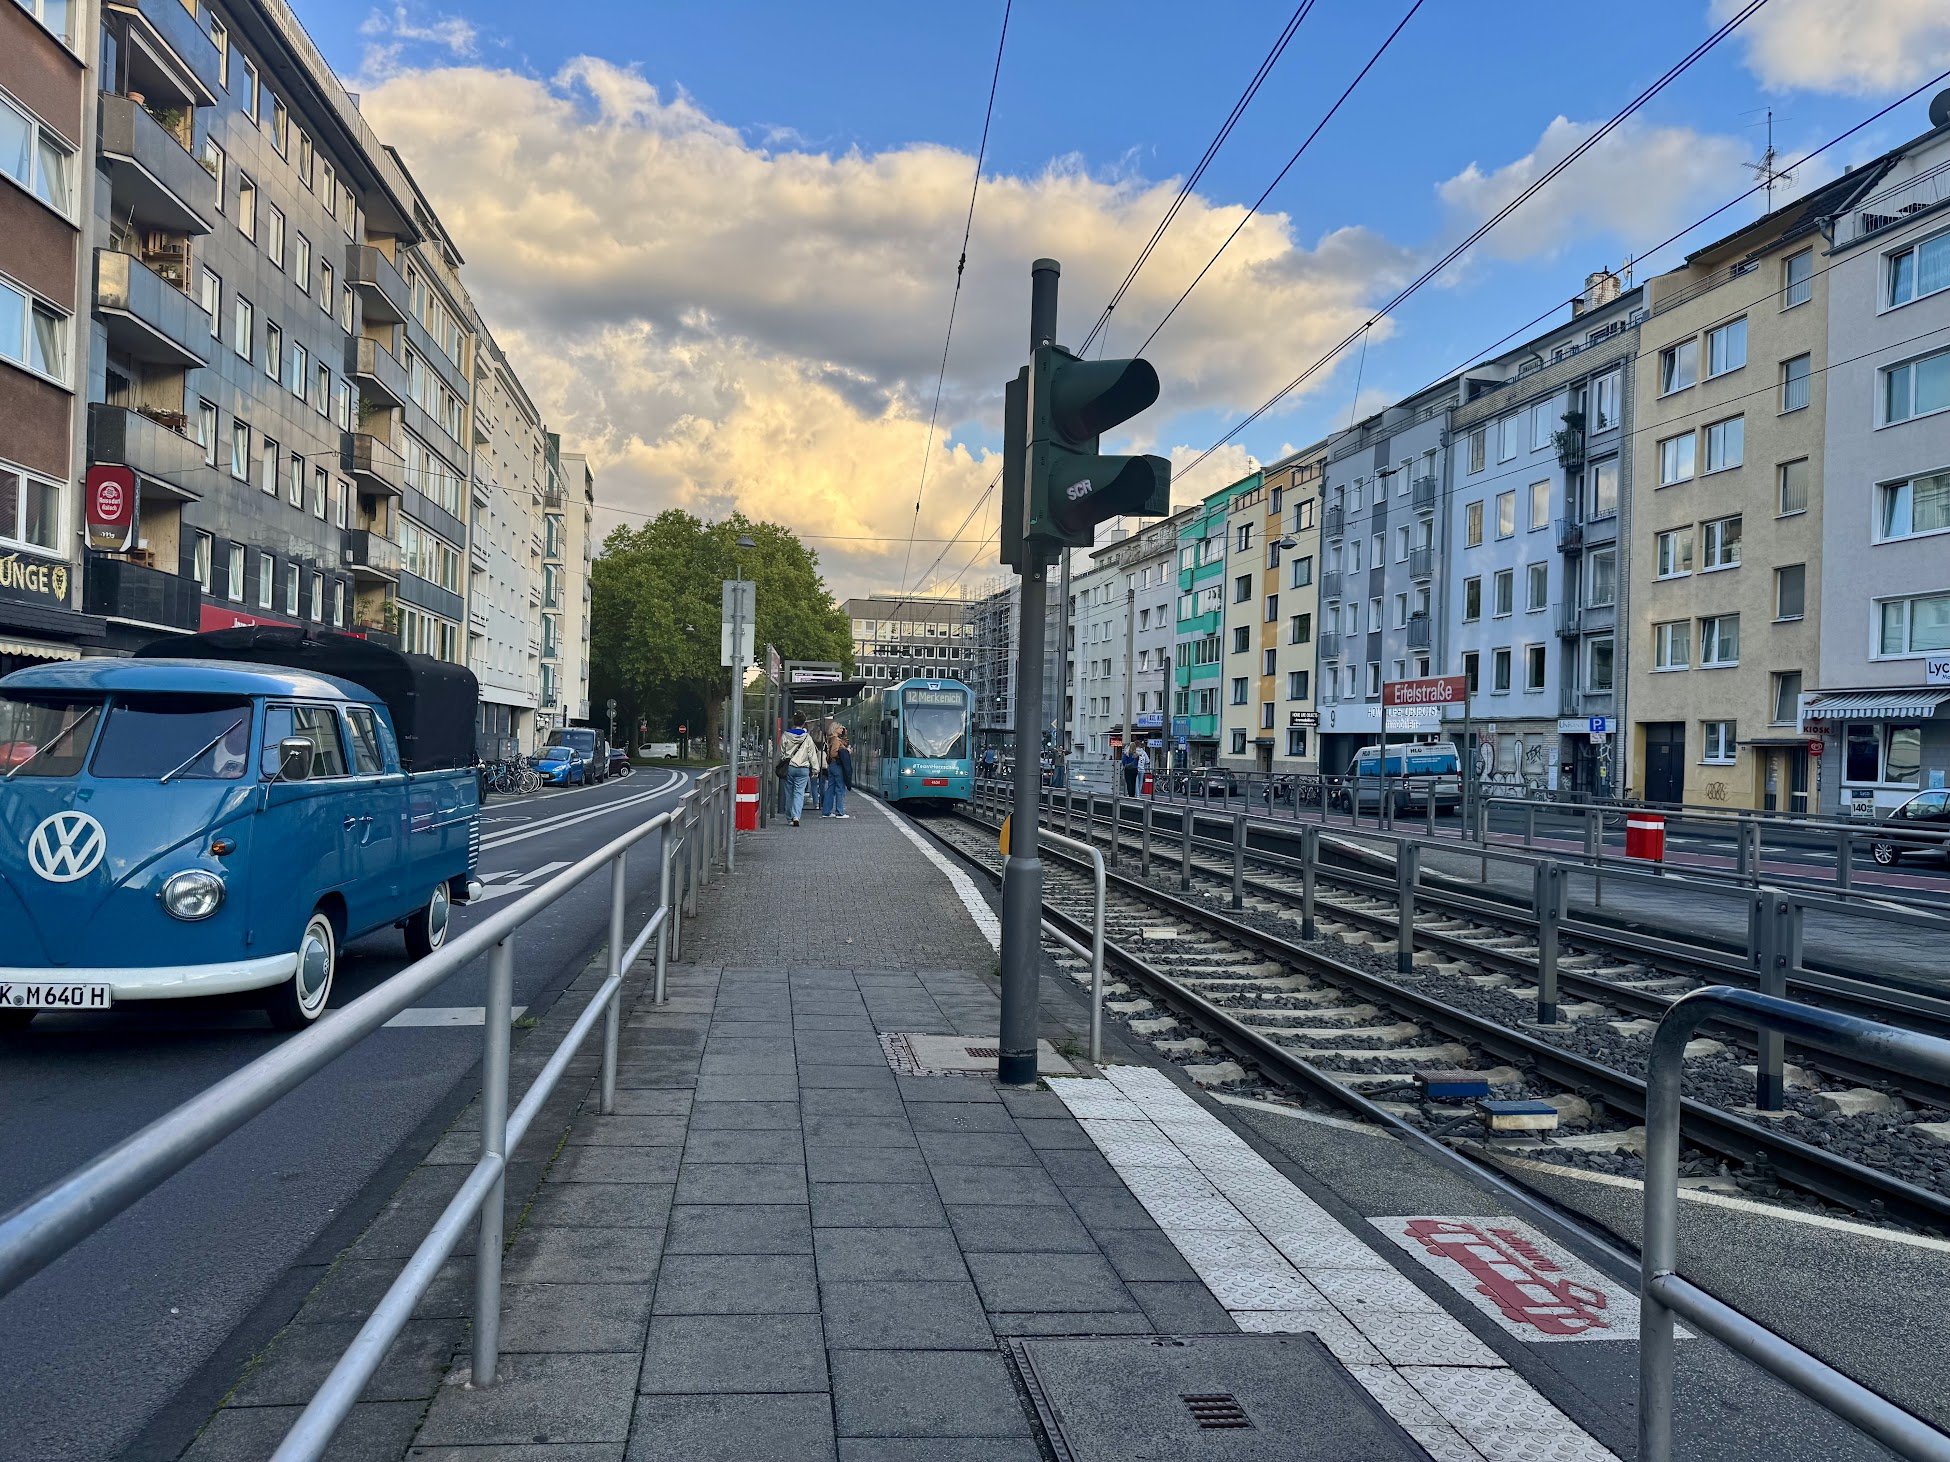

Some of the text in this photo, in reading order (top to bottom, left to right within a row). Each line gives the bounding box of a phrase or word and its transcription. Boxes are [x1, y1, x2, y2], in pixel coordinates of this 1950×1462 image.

[908, 691, 961, 703] 12 Merkenich
[1394, 680, 1453, 703] Eifelstraße
[1330, 710, 1336, 728] 9
[1368, 707, 1382, 718] HOM
[1593, 719, 1602, 730] P
[1853, 803, 1867, 812] 140
[30, 813, 104, 881] VW
[0, 986, 12, 1004] K
[90, 987, 105, 1006] H
